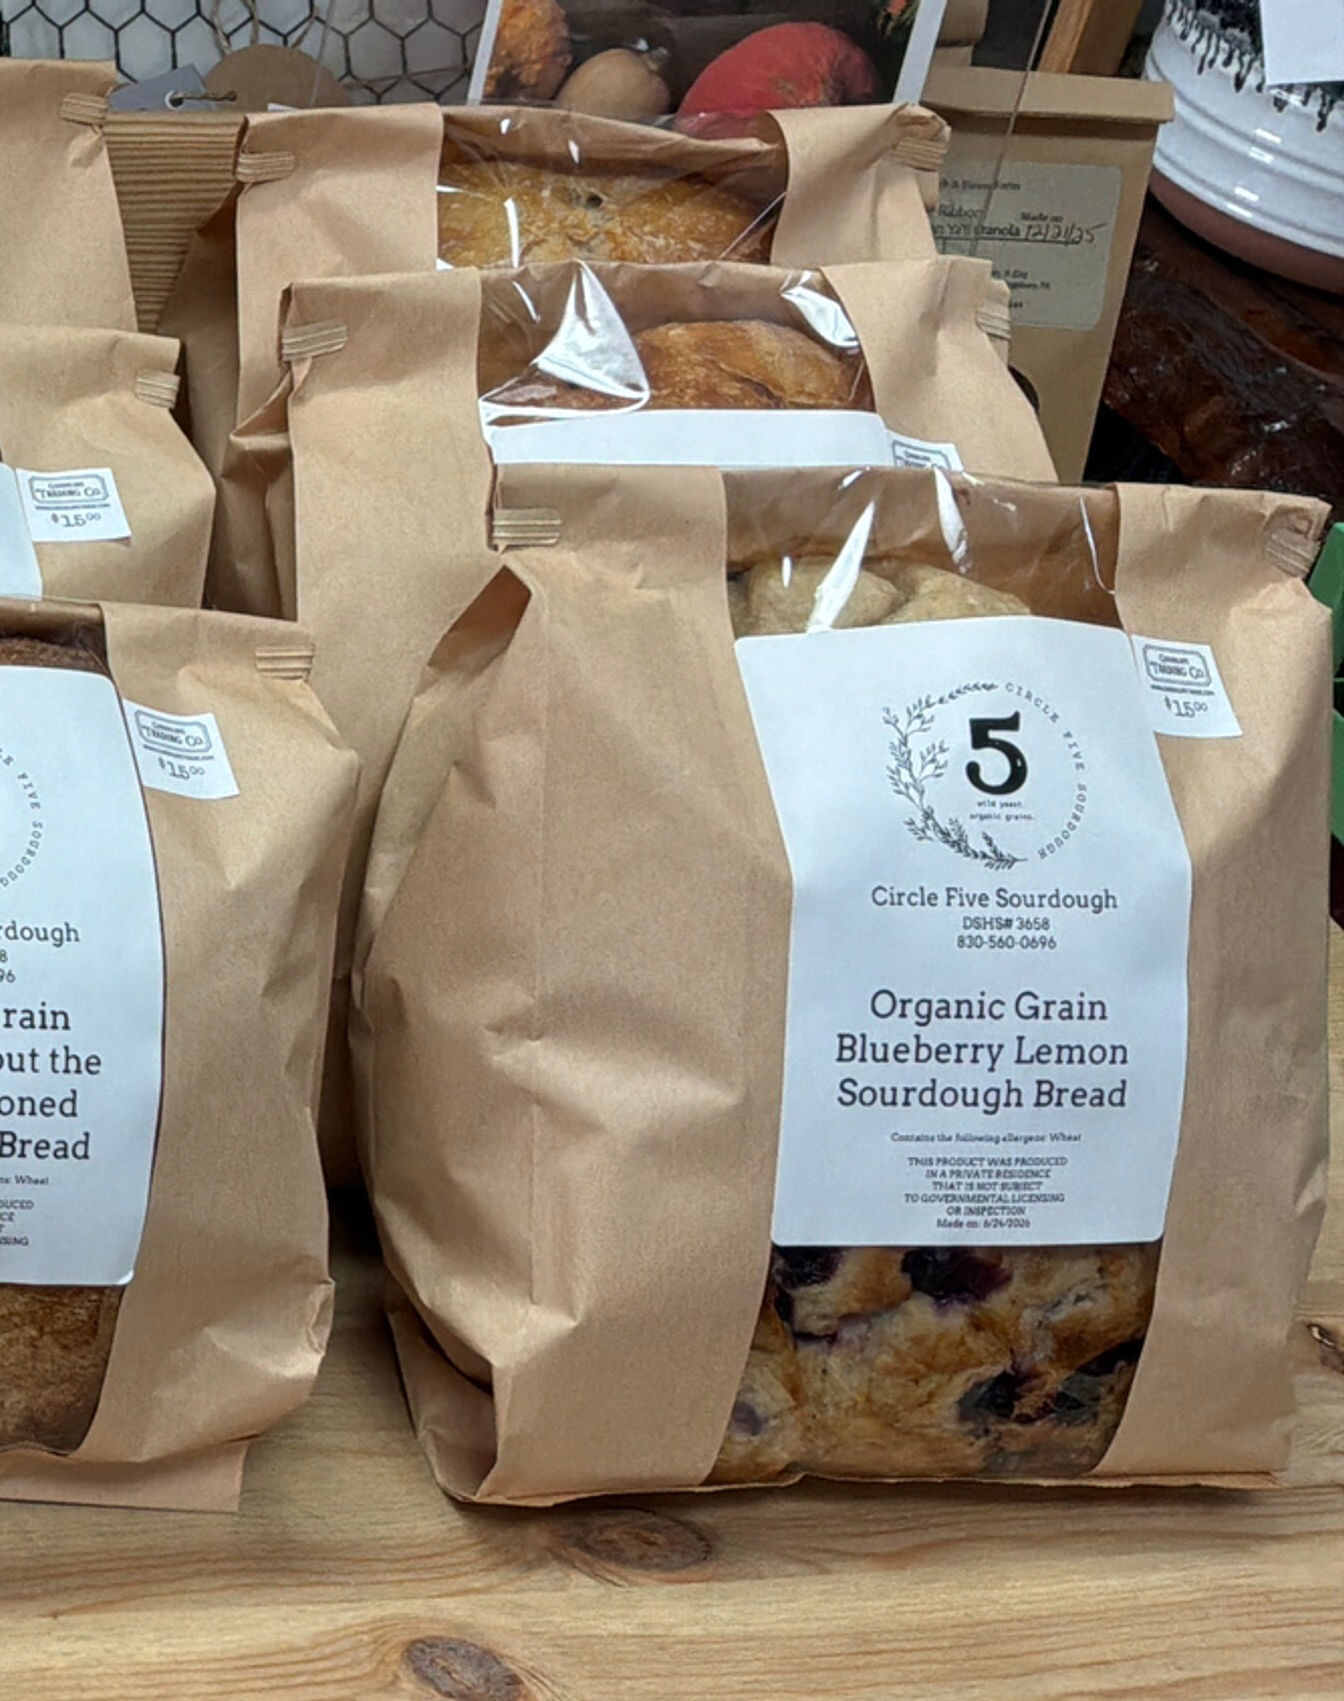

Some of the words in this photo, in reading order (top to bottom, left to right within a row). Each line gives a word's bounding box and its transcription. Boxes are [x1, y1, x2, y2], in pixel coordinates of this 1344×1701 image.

[1005, 682, 1060, 723] CIRCLE
[965, 710, 1028, 795] 5
[1062, 731, 1085, 771] FIVE
[17, 772, 40, 810] FIVE
[1037, 783, 1087, 859] SOURDOUGH
[871, 886, 938, 908] Circle
[945, 887, 990, 908] Five
[996, 888, 1118, 914] Sourdough
[963, 917, 1013, 930] DSHS#
[1016, 917, 1050, 930] 3658
[957, 936, 1056, 950] 830-560-0696
[870, 989, 1006, 1027] Organic
[1015, 991, 1108, 1020] Grain
[49, 1045, 102, 1075] the
[836, 1033, 1004, 1072] Blueberry
[1014, 1036, 1128, 1064] Lemon
[837, 1077, 1024, 1116] Sourdough
[1033, 1078, 1127, 1108] Bread
